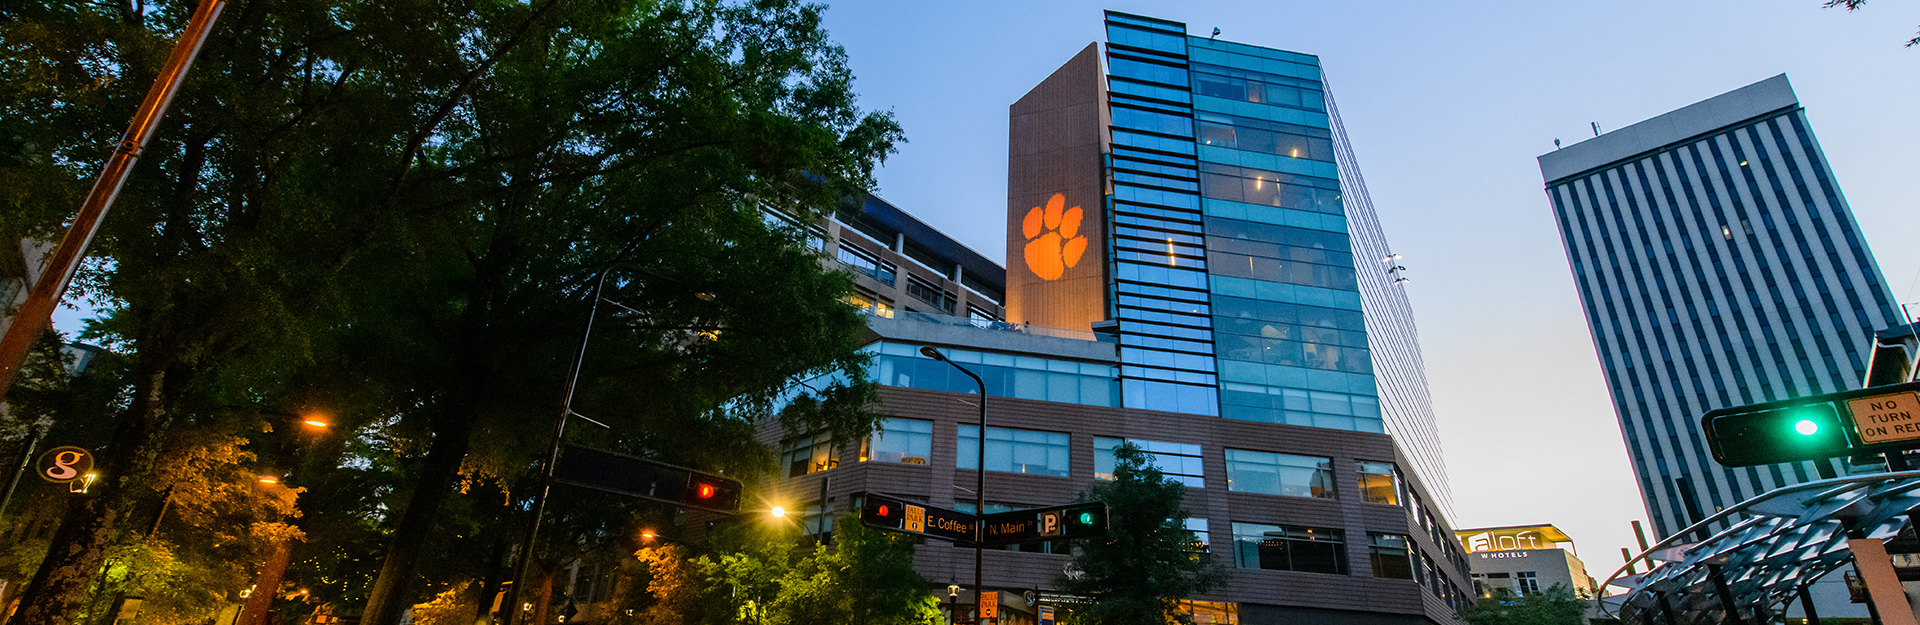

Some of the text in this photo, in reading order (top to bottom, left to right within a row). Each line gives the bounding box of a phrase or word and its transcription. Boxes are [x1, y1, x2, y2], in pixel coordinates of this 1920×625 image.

[1870, 400, 1897, 411] NO
[1868, 411, 1912, 424] TURN
[1865, 426, 1888, 437] ON
[907, 505, 924, 515] FALLS
[906, 513, 924, 523] PARK
[1045, 514, 1057, 533] P
[927, 515, 936, 528] E.
[938, 517, 967, 534] Coffee
[989, 524, 999, 535] N.
[1001, 522, 1025, 534] Main
[1467, 530, 1537, 553] aloft
[1491, 551, 1528, 559] HOTELS
